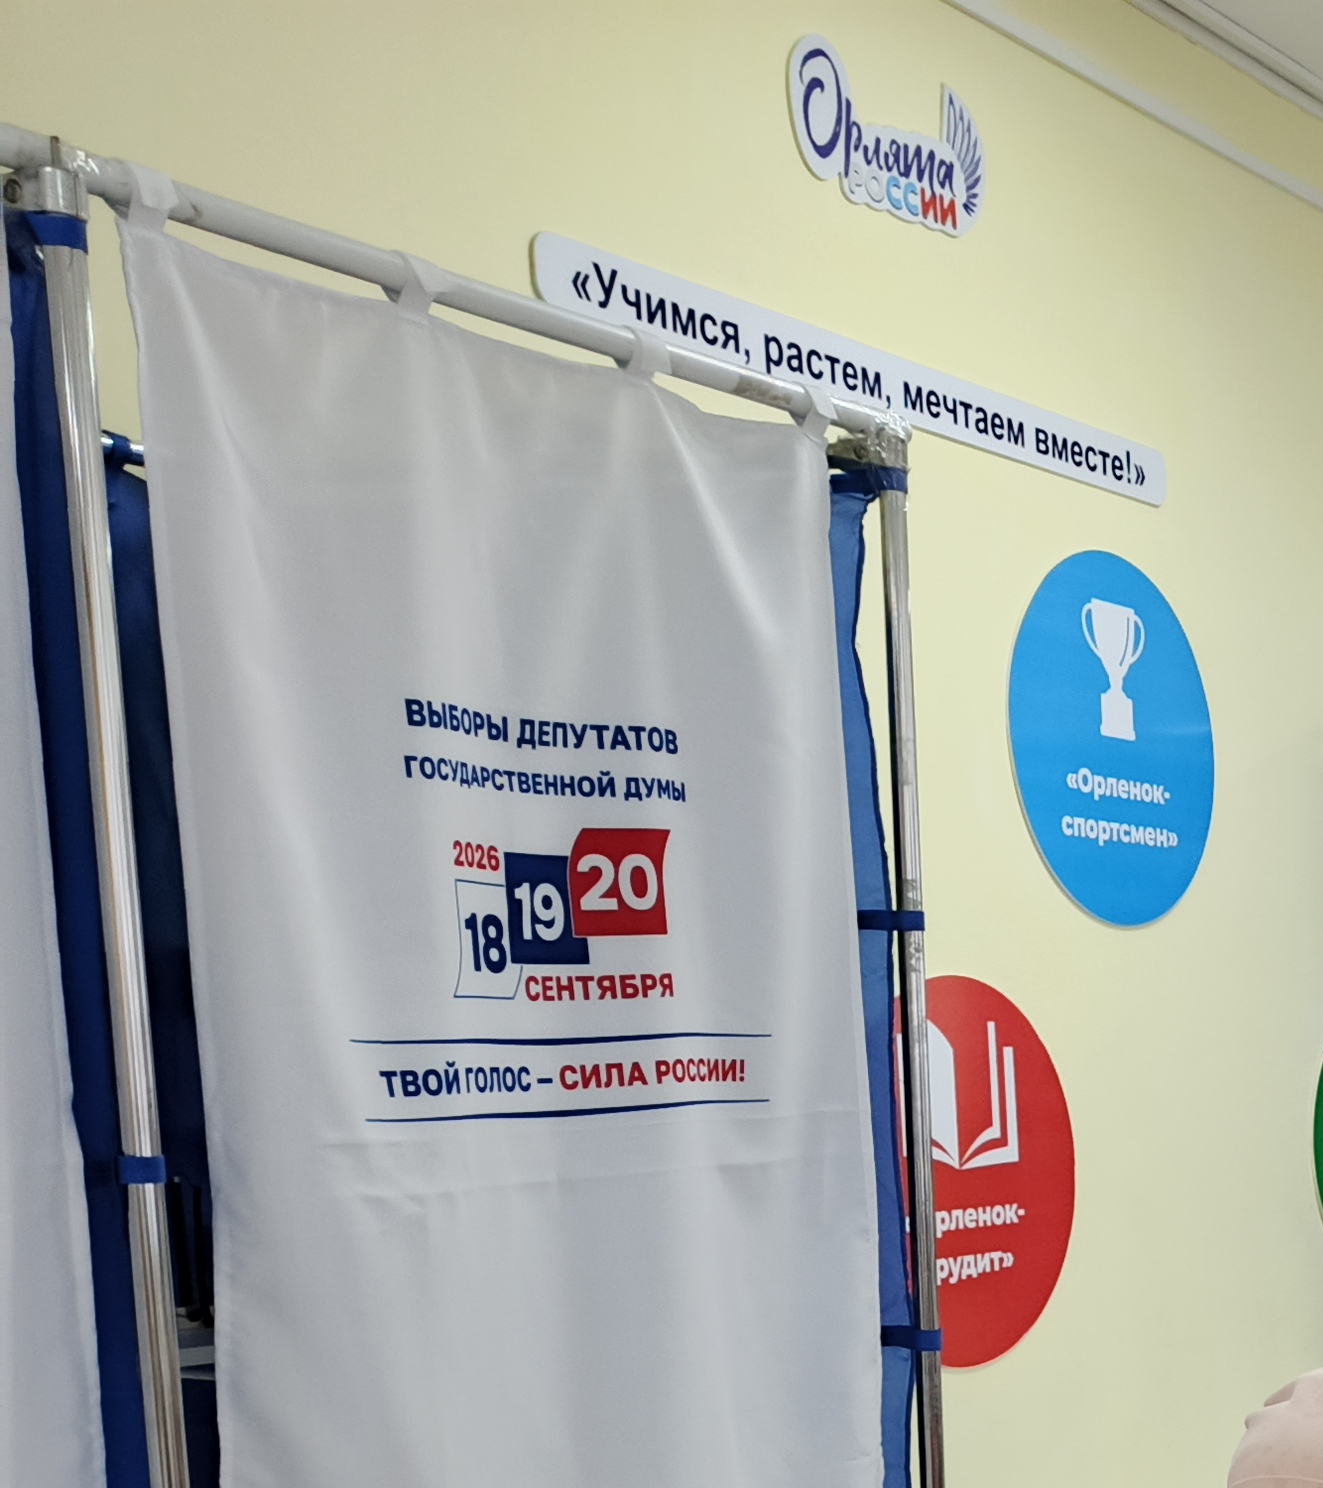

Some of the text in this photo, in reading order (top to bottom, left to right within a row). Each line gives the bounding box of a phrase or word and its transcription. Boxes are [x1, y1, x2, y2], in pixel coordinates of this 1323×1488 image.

[800, 48, 956, 195] Орлята
[848, 163, 958, 231] РОССИИ
[571, 262, 1147, 488] «Учимся, растем, мечтаем вместе!»
[404, 698, 679, 755] ВЫБОРЫ ДЕПУТАТОВ
[403, 754, 687, 802] ГОСУДАРСТВЕННОЙ ДУМЫ
[1066, 766, 1171, 805] «Орленок-
[1061, 813, 1179, 849] спортсмен»
[452, 840, 500, 871] 2026
[464, 853, 659, 974] 18 19 20
[524, 972, 675, 1002] СЕНТЯБРЯ
[379, 1061, 460, 1098] ТВОЙ
[465, 1066, 531, 1093] ГОЛОС
[559, 1061, 648, 1091] СИЛА
[655, 1058, 746, 1086] РОССИИ!
[936, 1203, 1025, 1239] рленок-
[936, 1249, 1015, 1285] рудит»
